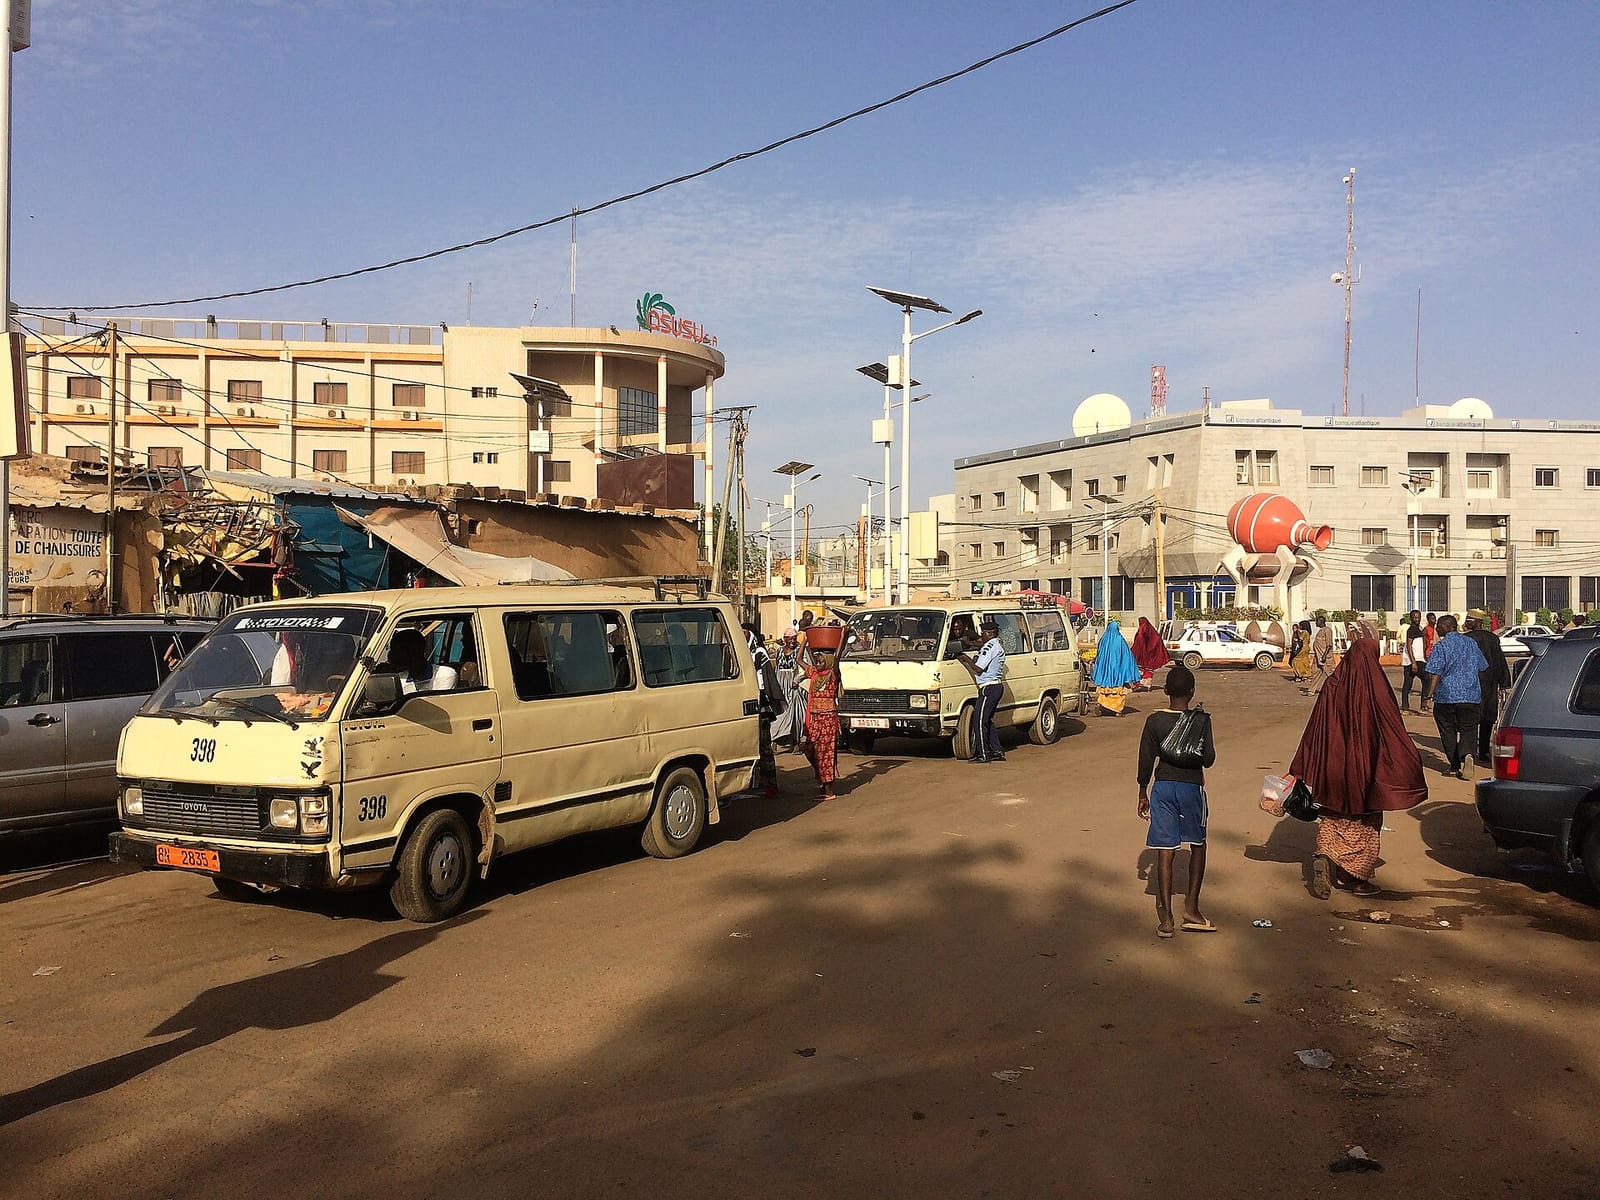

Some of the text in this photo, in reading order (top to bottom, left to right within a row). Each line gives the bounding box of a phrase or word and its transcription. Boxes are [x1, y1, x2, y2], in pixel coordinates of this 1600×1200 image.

[70, 529, 103, 544] TOUTE
[15, 540, 102, 558] DE CHAUSSURES
[260, 617, 313, 628] TOYOTA
[190, 737, 216, 763] 398
[180, 802, 209, 813] TOYOTA
[358, 794, 387, 822] 398
[180, 850, 210, 868] 2835
